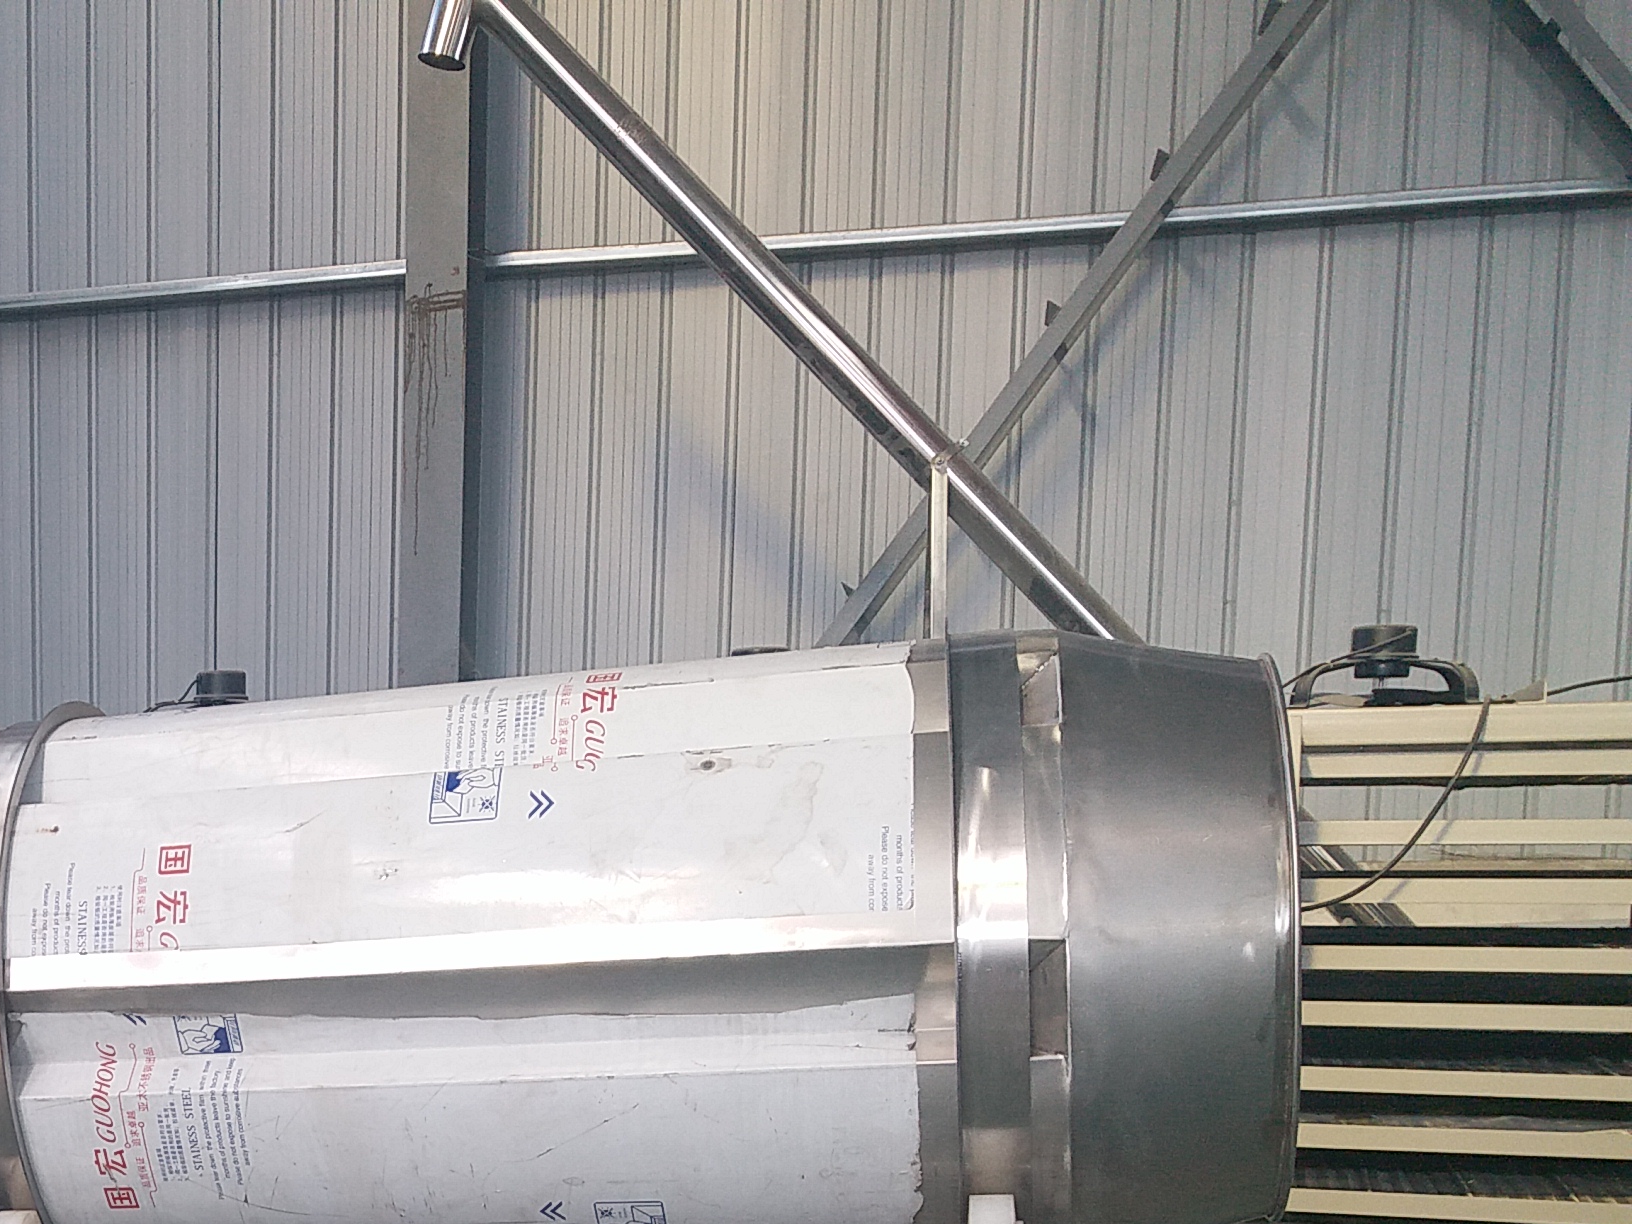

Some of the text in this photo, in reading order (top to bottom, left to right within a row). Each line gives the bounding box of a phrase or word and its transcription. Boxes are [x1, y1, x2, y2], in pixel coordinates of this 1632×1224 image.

[457, 715, 466, 726] not
[470, 711, 479, 722] of
[454, 727, 464, 752] expose
[467, 722, 477, 750] products
[454, 752, 463, 760] to
[467, 751, 476, 769] leave
[881, 825, 890, 853] Please
[895, 835, 904, 864] months
[866, 854, 875, 876] away
[881, 855, 890, 865] do
[67, 863, 76, 886] Please
[881, 867, 890, 880] not
[895, 866, 904, 874] of
[155, 844, 192, 924] 国宏
[868, 878, 877, 896] from
[43, 883, 52, 907] Please
[53, 891, 61, 917] months
[42, 909, 50, 918] do
[42, 919, 50, 930] not
[31, 929, 39, 945] from
[91, 1042, 119, 1143] GUOHONG
[198, 1094, 207, 1107] film
[209, 1090, 218, 1102] the
[211, 1103, 220, 1121] leave
[234, 1103, 245, 1134] corrosive
[181, 1088, 204, 1171] STAINESS STEEL
[200, 1108, 213, 1140] protective
[226, 1122, 237, 1145] expose
[205, 1140, 214, 1151] the
[214, 1122, 225, 1150] products
[238, 1134, 247, 1149] from
[126, 1110, 152, 1188] 品质保证 追求卓越
[230, 1145, 238, 1156] not
[209, 1154, 217, 1170] down
[221, 1157, 231, 1179] months
[232, 1156, 240, 1166] do
[94, 1149, 140, 1209] 国宏
[235, 1166, 244, 1186] Please
